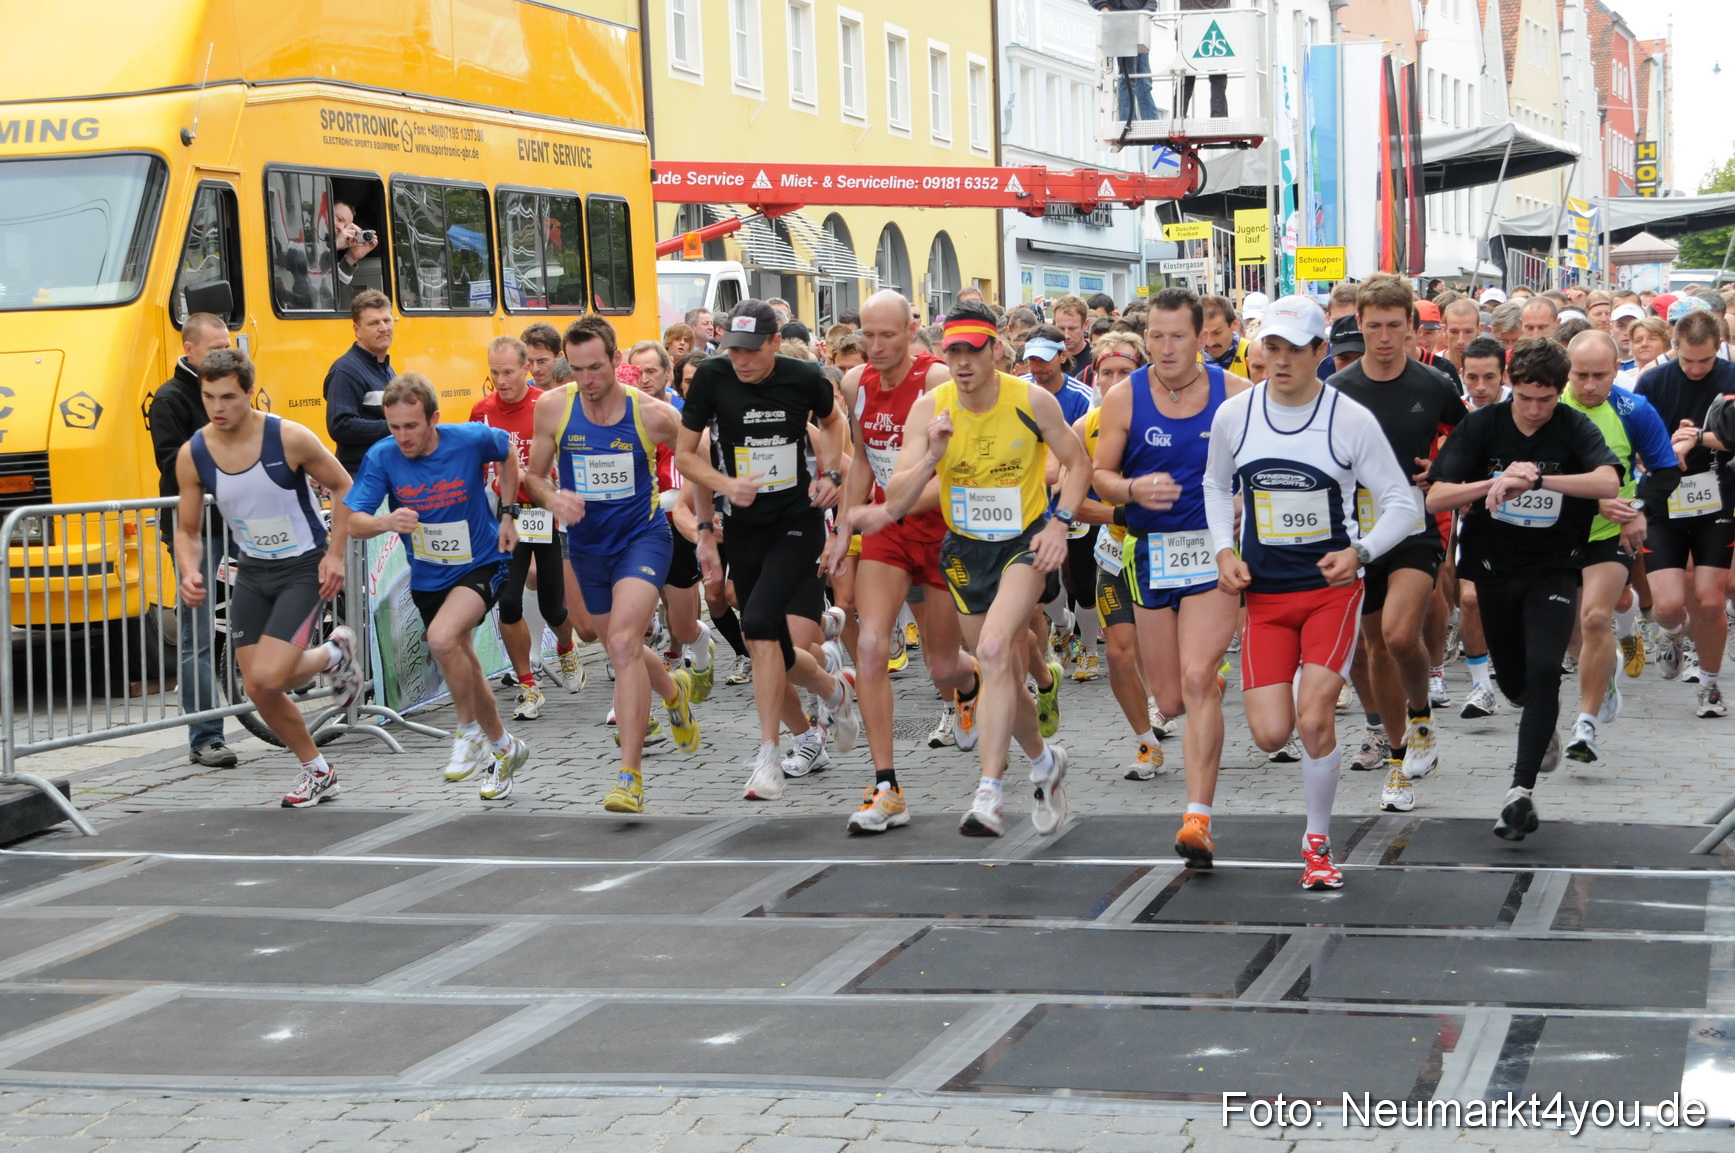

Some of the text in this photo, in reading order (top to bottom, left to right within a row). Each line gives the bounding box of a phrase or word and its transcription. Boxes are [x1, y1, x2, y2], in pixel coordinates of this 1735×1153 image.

[320, 108, 399, 138] SPORTRONIC
[413, 122, 426, 136] Fon:
[323, 135, 400, 152] ELECTRONIC SPORTS EQUIPMENT
[517, 138, 593, 169] EVENT SERVICE
[687, 171, 744, 186] Service
[780, 173, 998, 190] Miet- & Serviceline: 09181 6352
[1175, 225, 1200, 233] Duschen
[1236, 223, 1269, 235] Jugend-
[1245, 234, 1260, 244] lauf
[1163, 259, 1204, 272] Klostergasse
[1298, 256, 1342, 265] Schnupper-
[440, 388, 472, 398] VIDEO SYSTEMS
[288, 398, 322, 408] ELA-SYSTEME
[567, 434, 586, 442] UBH
[744, 435, 789, 447] PowerBar
[752, 452, 774, 461] Artur
[589, 460, 615, 468] Helmut
[768, 464, 778, 477] 4
[591, 471, 628, 485] 3355
[1270, 479, 1305, 487] SPORTS
[1680, 481, 1697, 489] Andy
[969, 492, 996, 502] Marco
[1512, 495, 1554, 510] 3239
[1686, 489, 1712, 503] 645
[971, 507, 1013, 521] 2000
[1282, 512, 1318, 528] 996
[522, 519, 544, 531] 930
[254, 531, 290, 547] 2202
[431, 539, 460, 552] 622
[1167, 537, 1205, 548] Wolfgang
[1170, 550, 1210, 568] 2612
